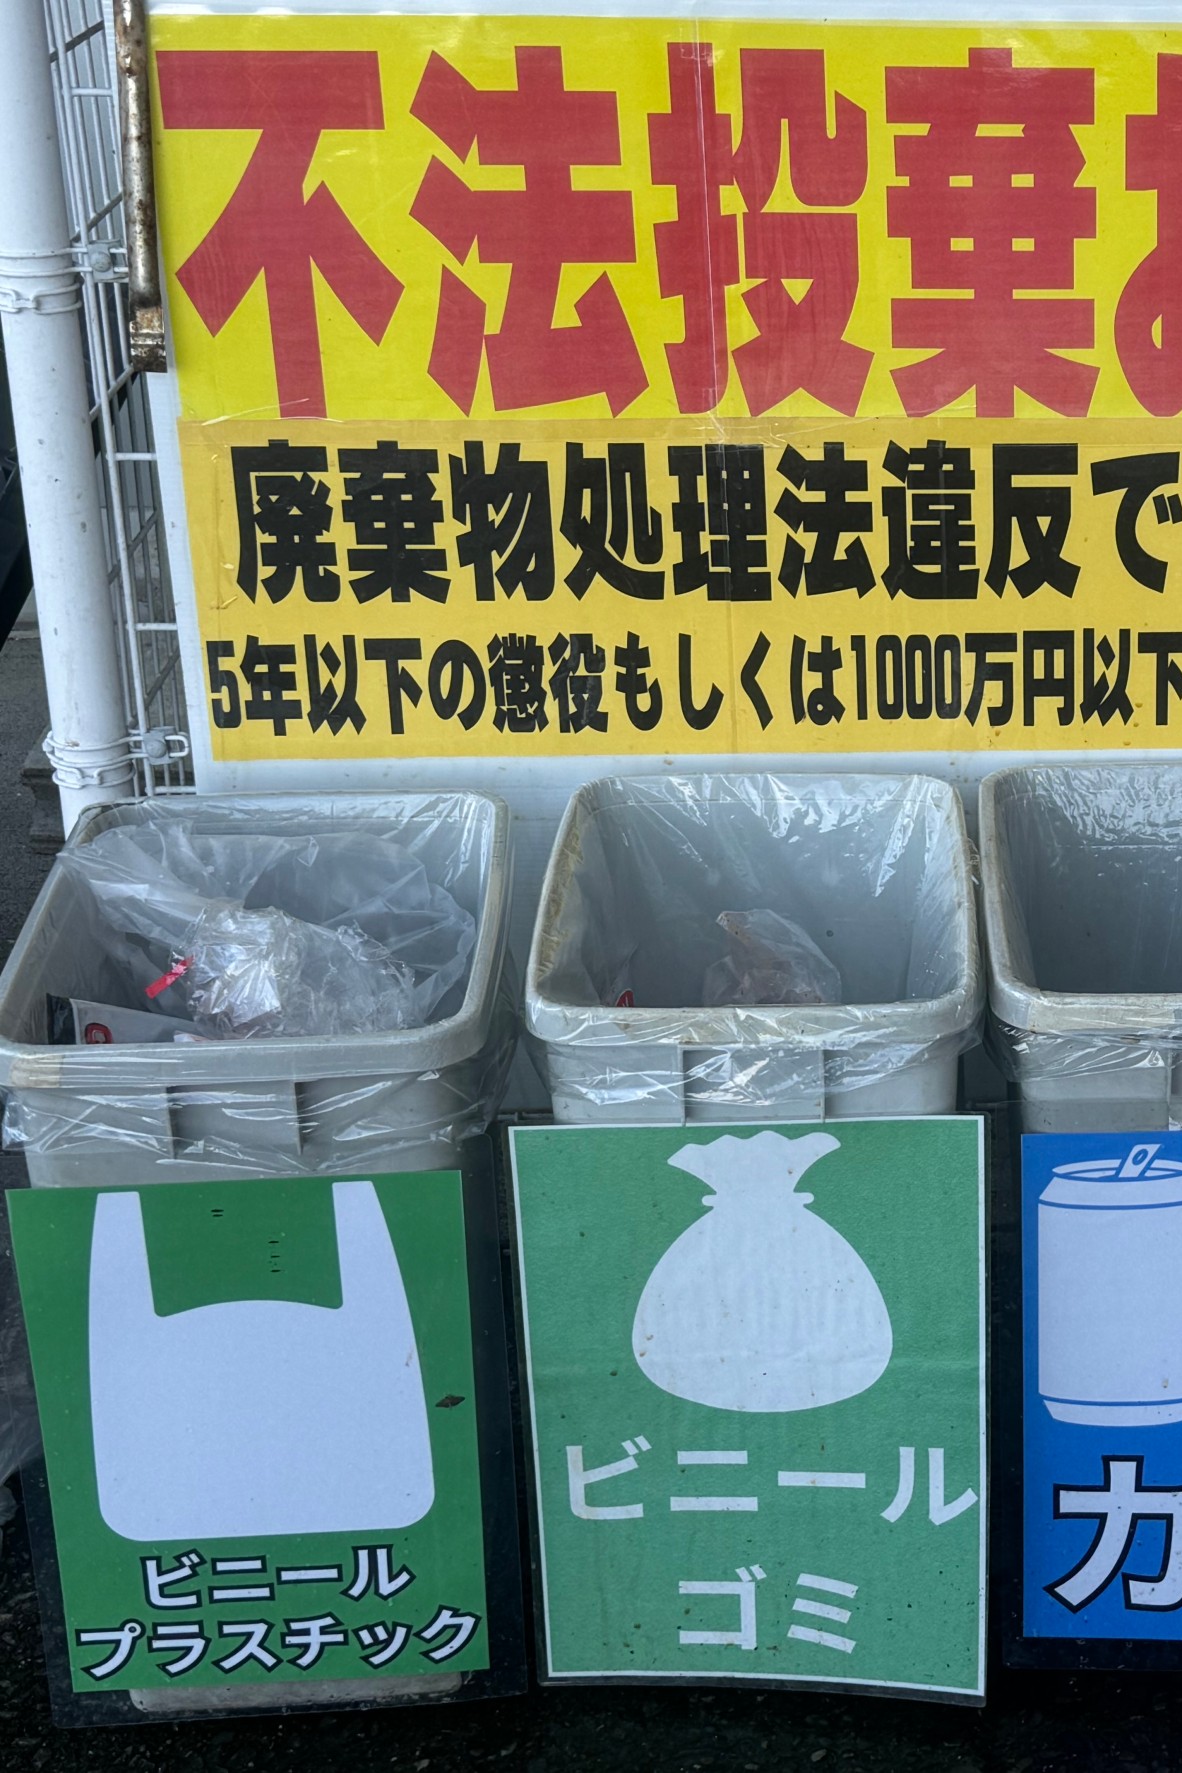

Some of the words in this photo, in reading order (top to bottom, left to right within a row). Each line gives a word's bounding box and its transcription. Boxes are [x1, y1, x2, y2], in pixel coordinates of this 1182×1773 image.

[565, 1436, 978, 1526] ビニール
[139, 1543, 416, 1613] ビニール
[677, 1565, 860, 1653] ゴミ
[76, 1604, 482, 1680] プラスチック
